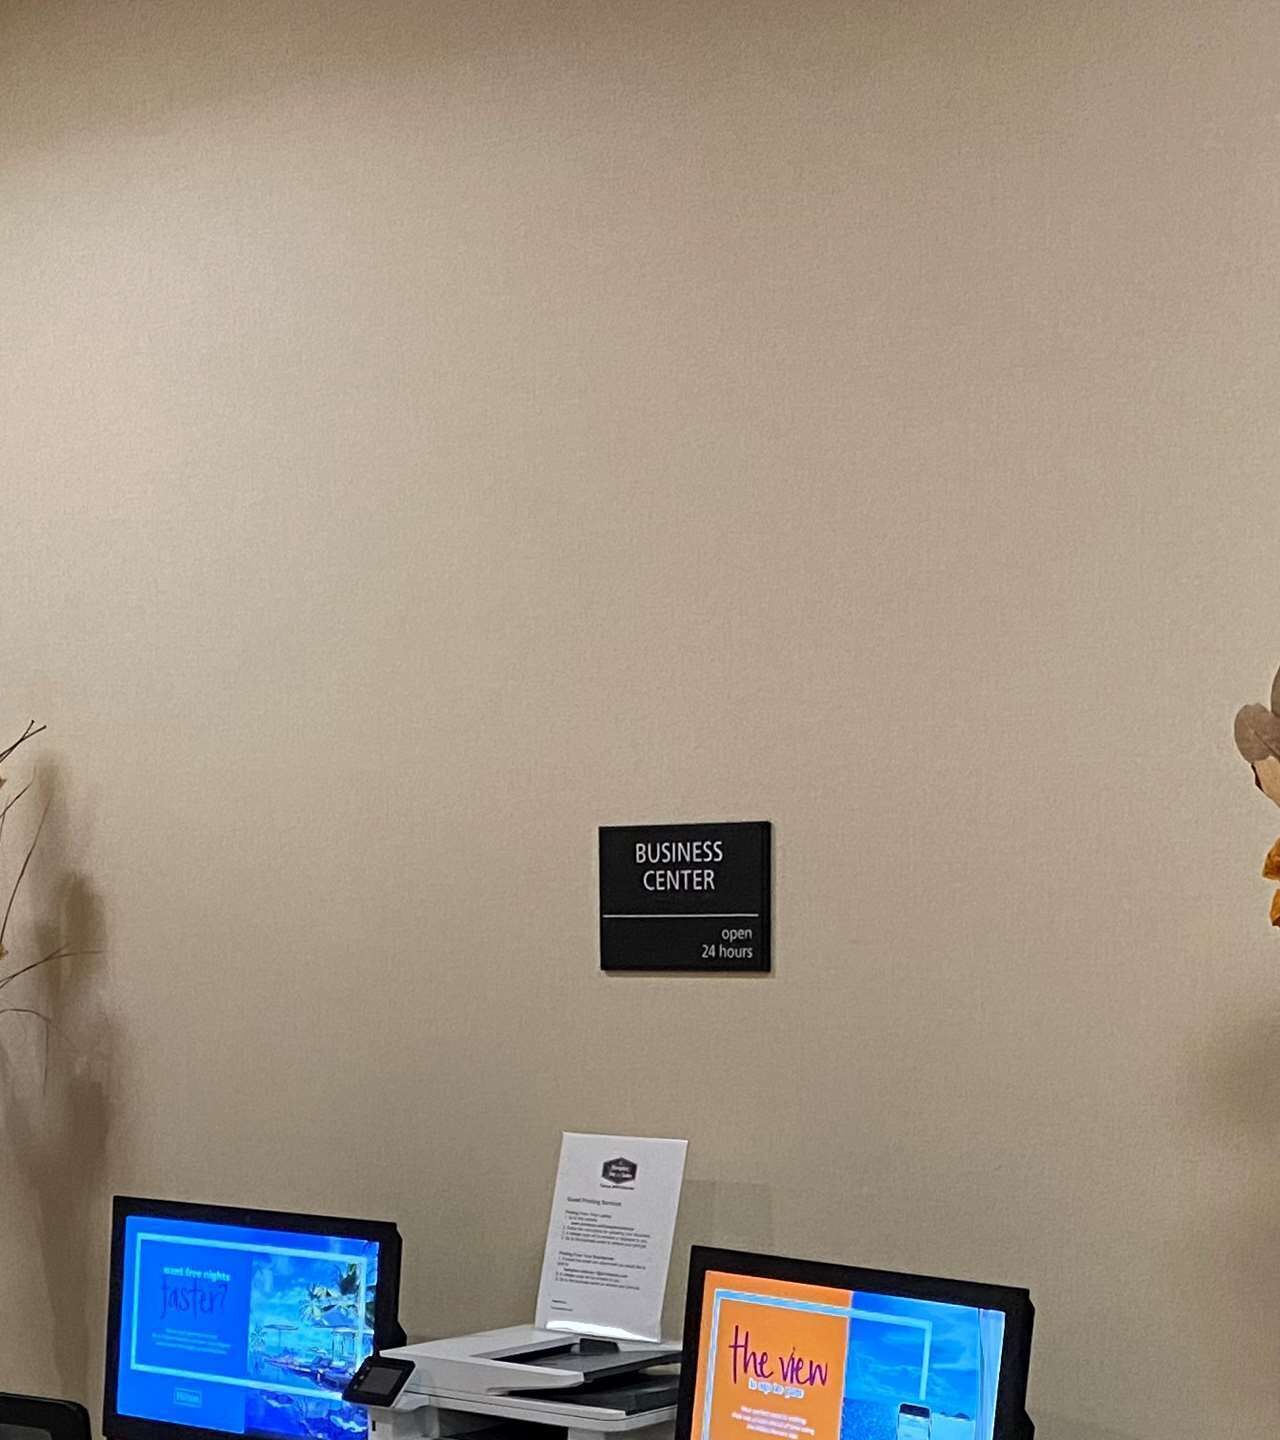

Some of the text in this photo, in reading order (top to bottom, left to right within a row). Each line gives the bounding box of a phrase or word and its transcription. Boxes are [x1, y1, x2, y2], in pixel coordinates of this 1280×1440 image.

[635, 840, 724, 863] BUSINESS
[642, 869, 716, 891] CENTER
[721, 928, 753, 943] open
[701, 944, 753, 959] 24 hours
[185, 1267, 202, 1278] free
[203, 1270, 231, 1283] nights
[160, 1278, 228, 1320] faster?
[728, 1324, 828, 1387] the view
